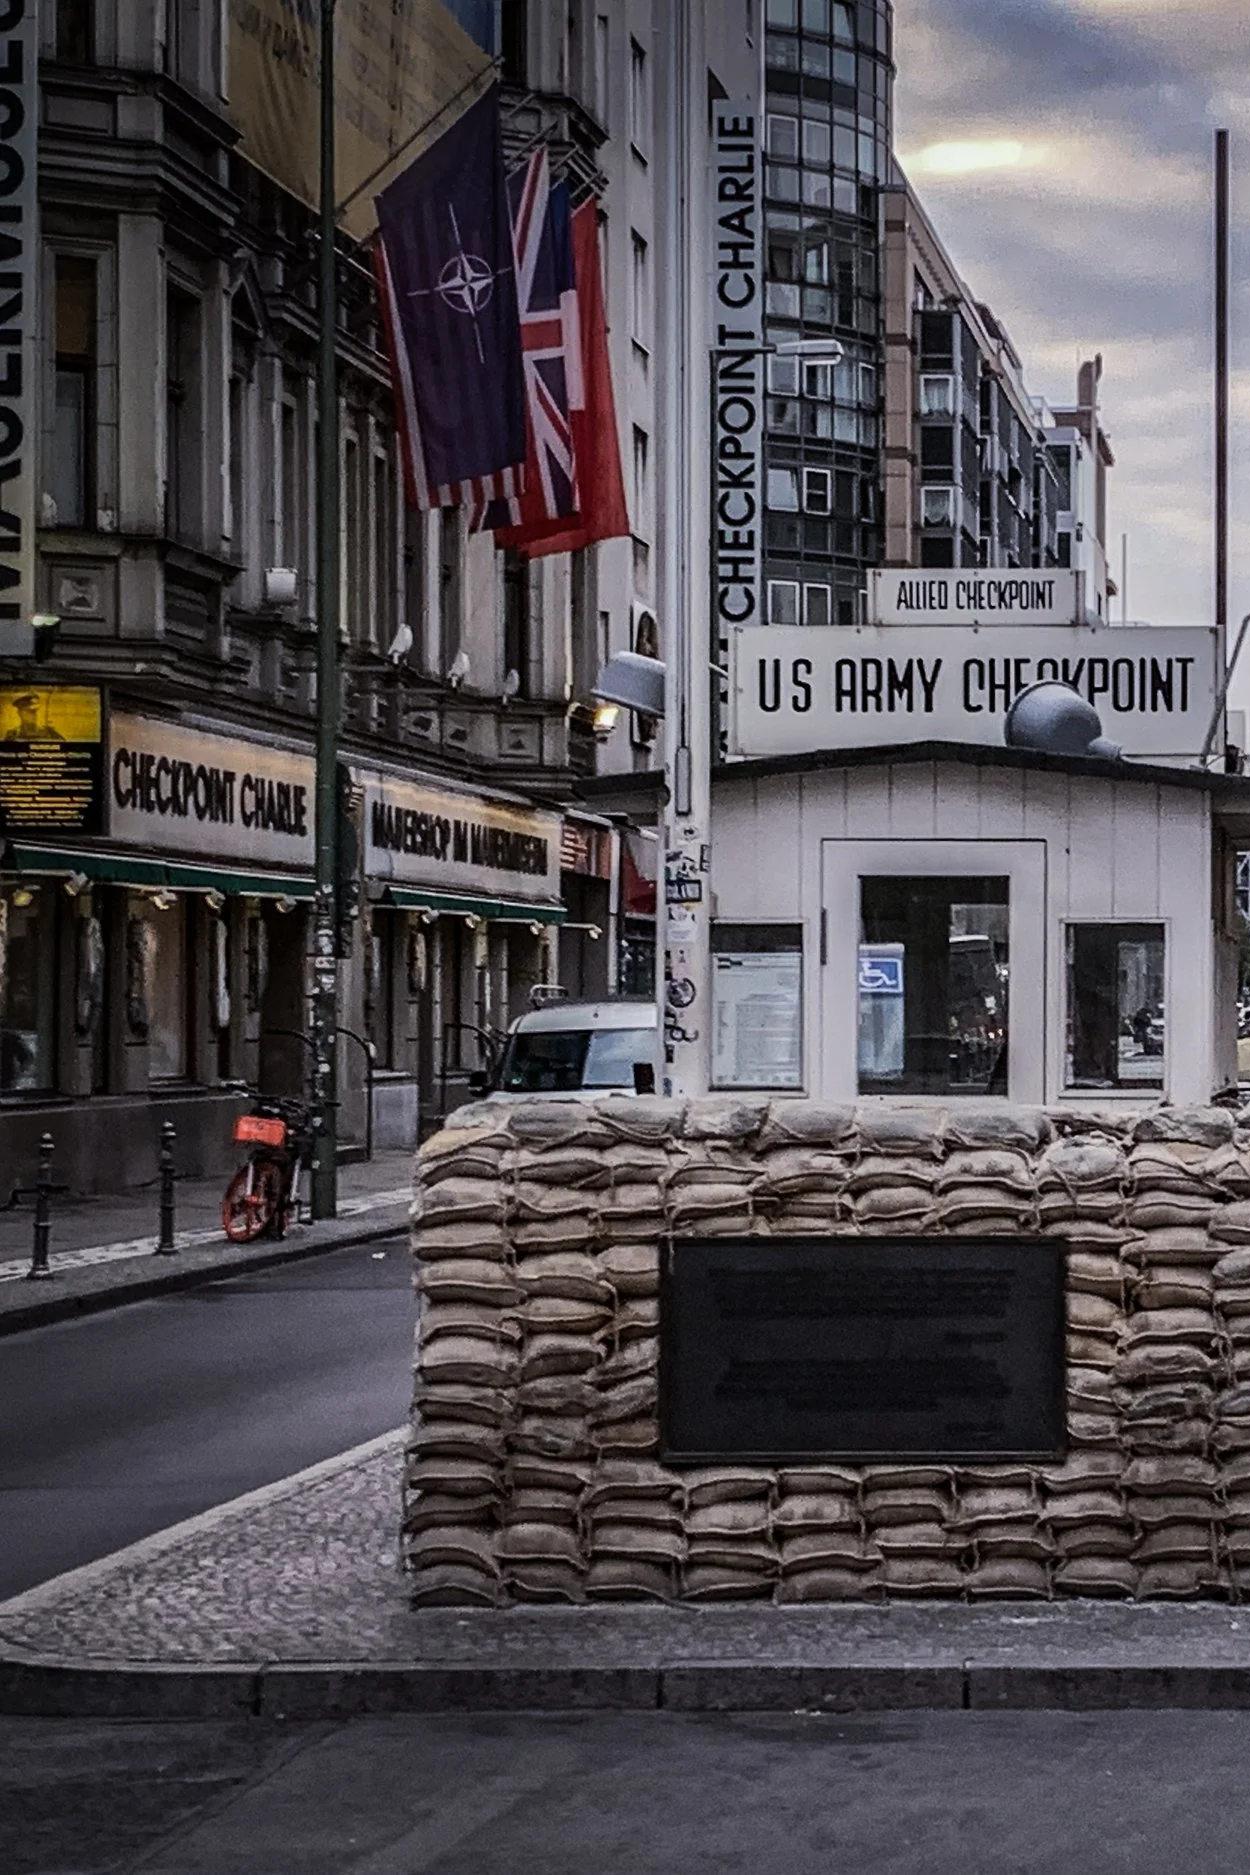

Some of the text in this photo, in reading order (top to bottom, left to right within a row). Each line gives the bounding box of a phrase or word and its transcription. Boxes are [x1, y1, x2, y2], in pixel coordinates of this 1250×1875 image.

[717, 115, 756, 623] CHECKPOINT CHARLIE
[897, 580, 1056, 611] ALLIED CHECKPOINT
[758, 658, 812, 713] US
[835, 657, 942, 713] ARMY
[112, 747, 236, 824] CHECKPOINT
[240, 773, 308, 837] CHARLIE
